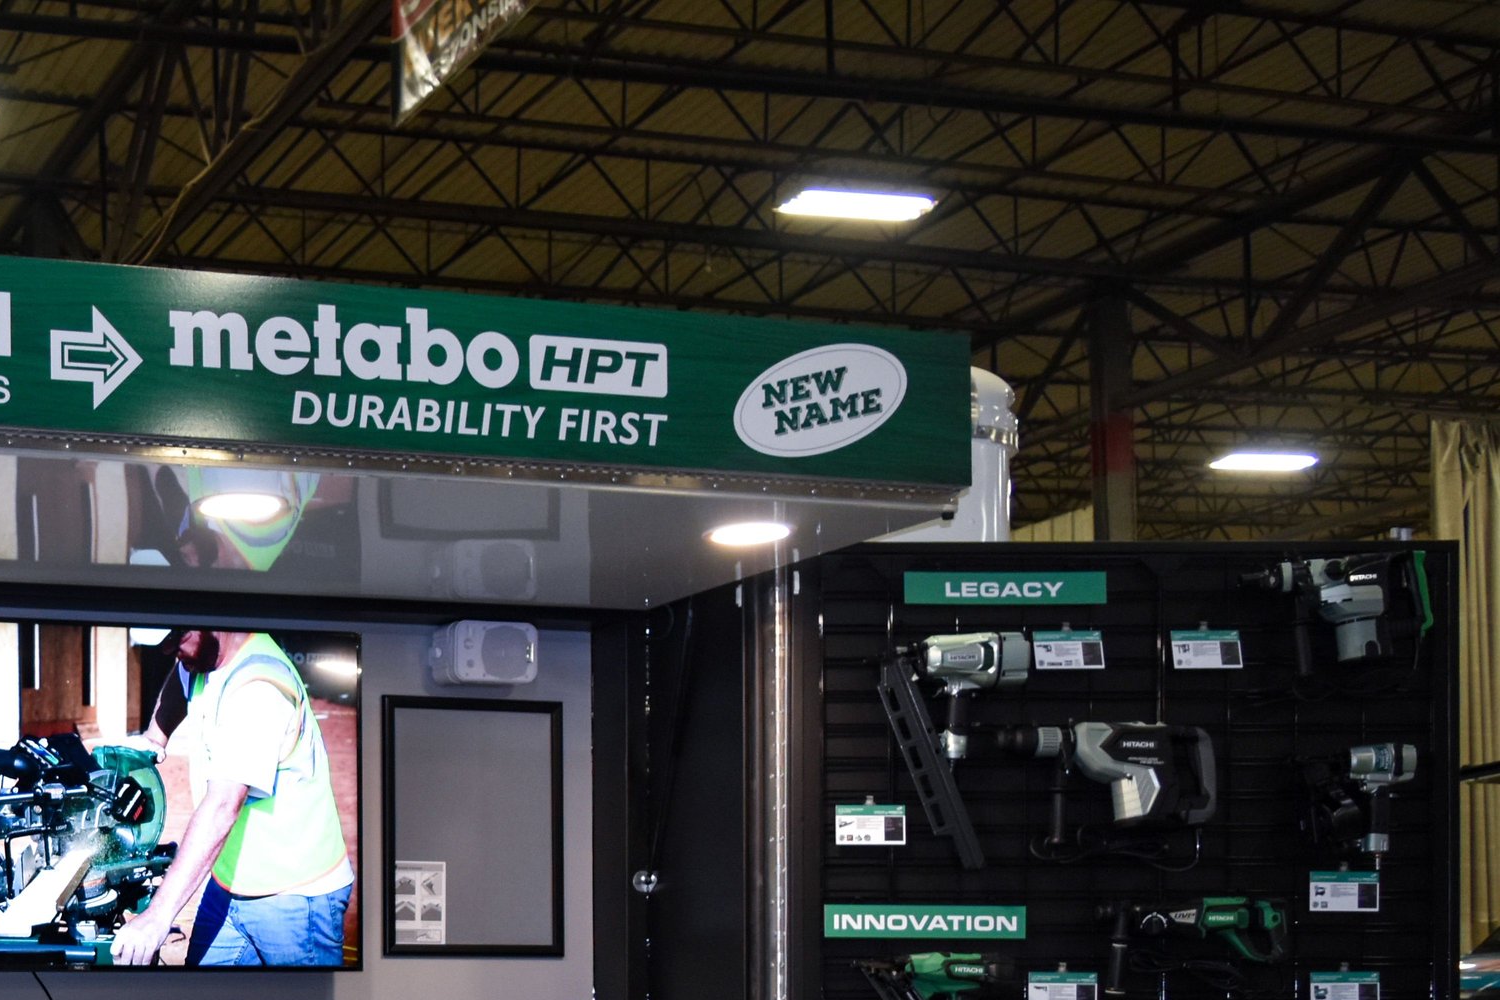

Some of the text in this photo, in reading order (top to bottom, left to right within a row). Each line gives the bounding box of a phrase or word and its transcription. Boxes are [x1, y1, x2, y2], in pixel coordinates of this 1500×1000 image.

[169, 303, 663, 392] metabo HPT
[762, 366, 848, 409] NEW
[291, 390, 669, 447] DURABILITY FIRST
[774, 388, 883, 436] NAME
[944, 581, 1064, 598] LEGACY
[1122, 740, 1155, 748] HITACHI
[833, 913, 1018, 932] INNOVATION
[954, 965, 984, 975] HITACHI
